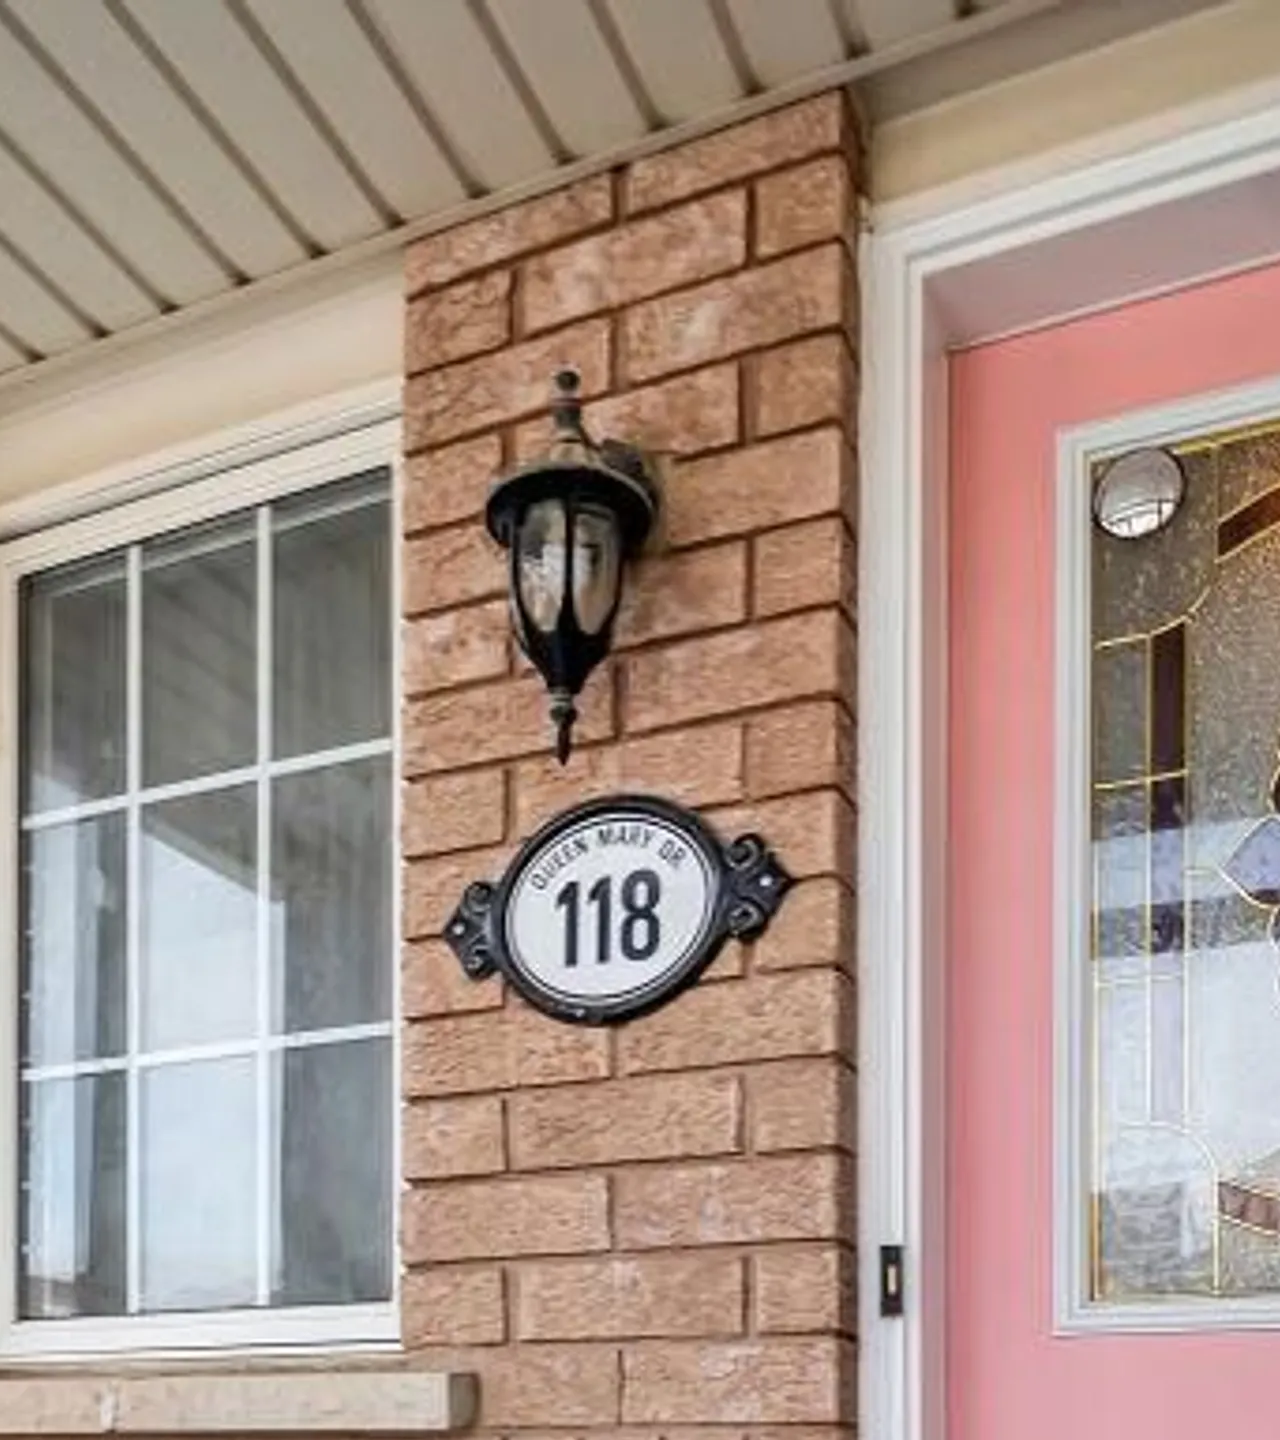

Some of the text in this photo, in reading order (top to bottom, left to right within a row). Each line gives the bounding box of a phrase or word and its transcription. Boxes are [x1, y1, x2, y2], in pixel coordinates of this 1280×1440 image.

[531, 838, 589, 890] QUEEN
[598, 825, 653, 848] MARY
[555, 869, 661, 967] 118
